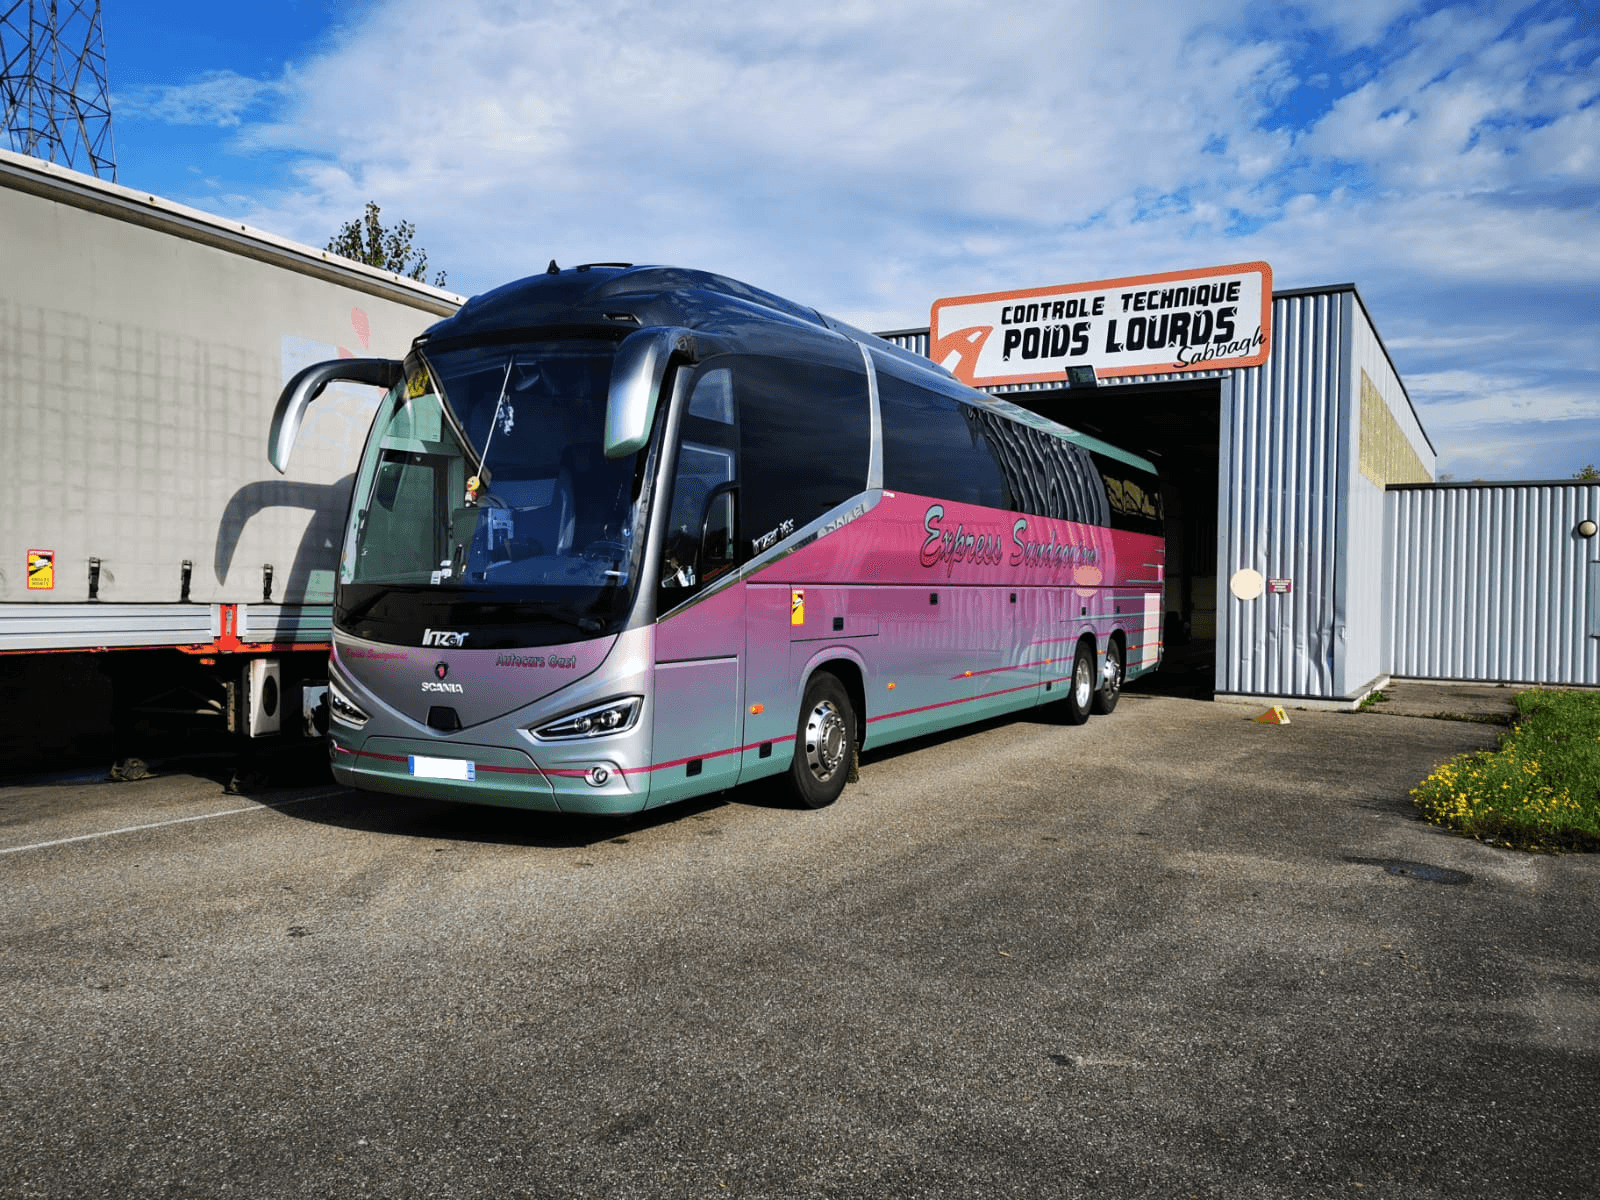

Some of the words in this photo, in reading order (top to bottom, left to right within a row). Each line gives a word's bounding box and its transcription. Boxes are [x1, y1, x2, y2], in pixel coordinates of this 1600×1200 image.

[1001, 296, 1105, 325] CONTROLE
[1121, 281, 1241, 312] TECHNIQUE
[1003, 322, 1091, 361] POIDS
[1105, 306, 1238, 354] LOURDS
[1173, 326, 1267, 368] Sabbagh
[920, 504, 1003, 578] Express
[421, 681, 463, 694] SCANIA
